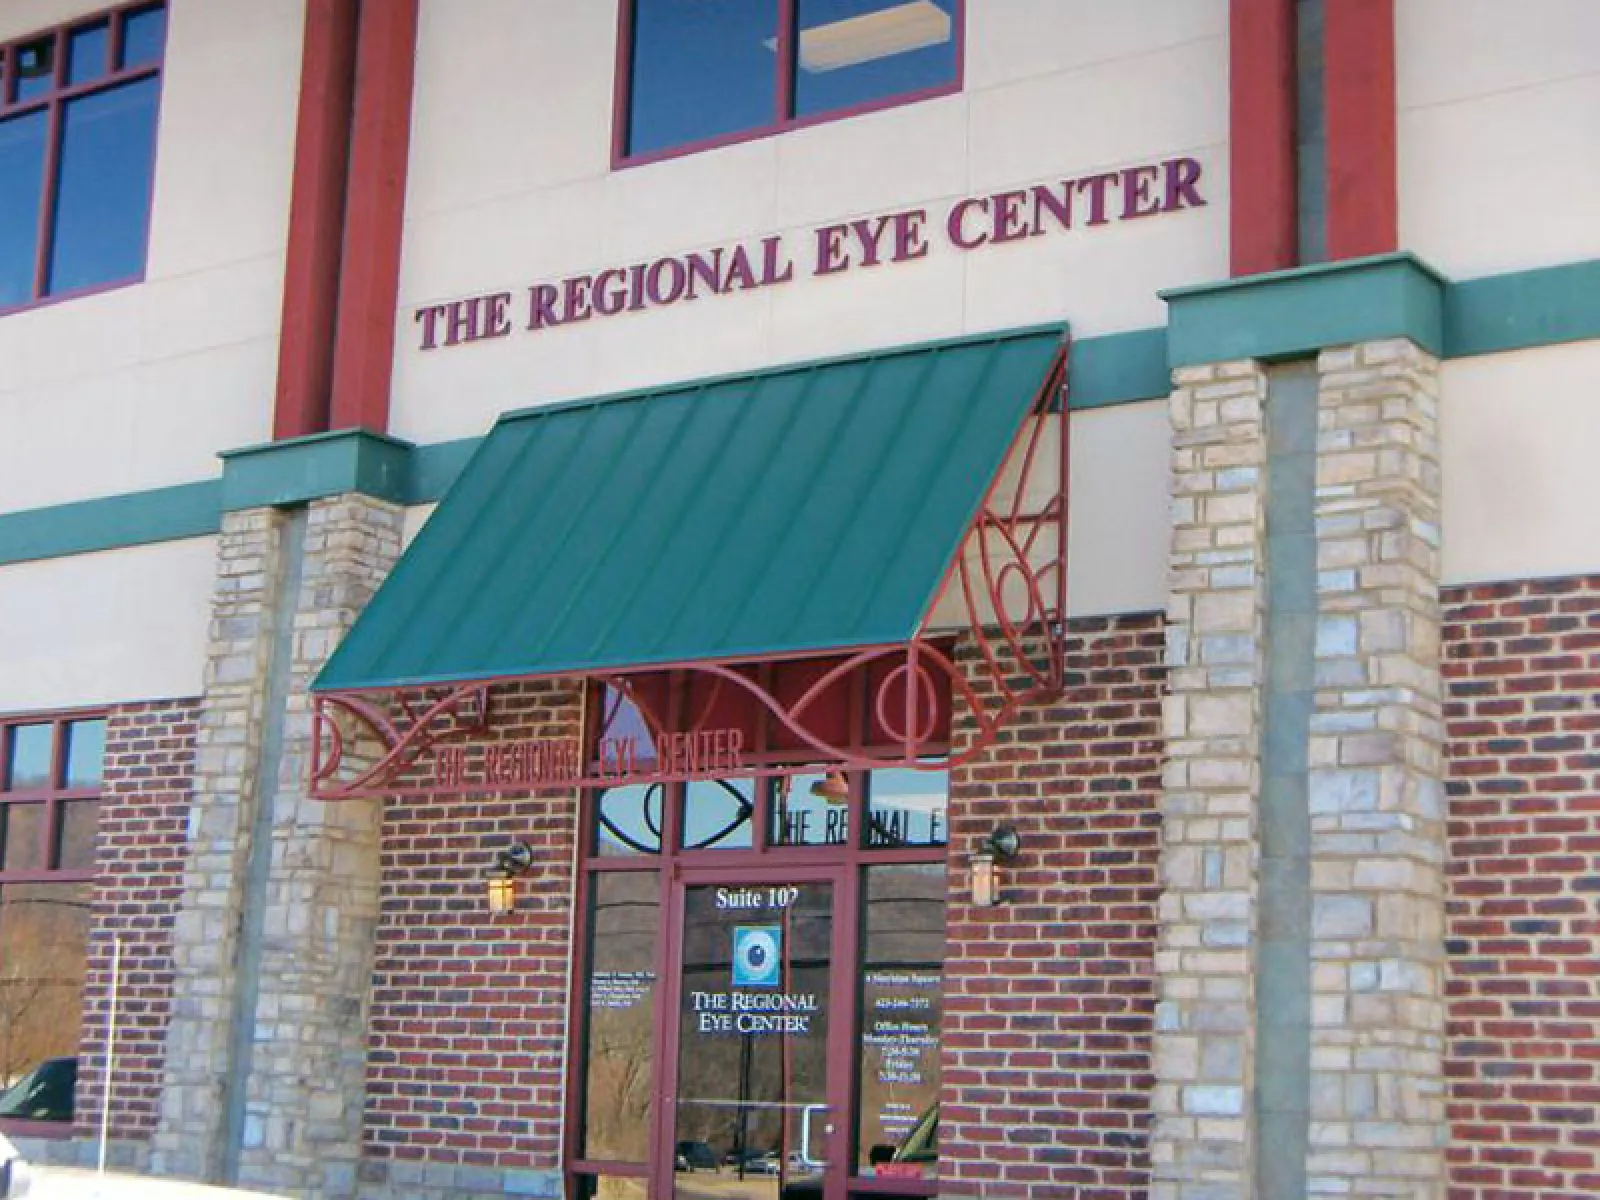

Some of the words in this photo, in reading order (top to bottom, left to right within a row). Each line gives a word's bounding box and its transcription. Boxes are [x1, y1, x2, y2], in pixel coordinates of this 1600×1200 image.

[415, 291, 511, 350] THE
[527, 235, 793, 331] REGIONAL
[812, 208, 929, 276] EYE
[946, 156, 1207, 250] CENTER
[657, 727, 745, 778] CENTER
[715, 887, 763, 909] Suite
[691, 991, 727, 1011] THE
[731, 991, 818, 1012] REGIONAL
[699, 1012, 733, 1033] EYE
[737, 1013, 809, 1033] CENTER
